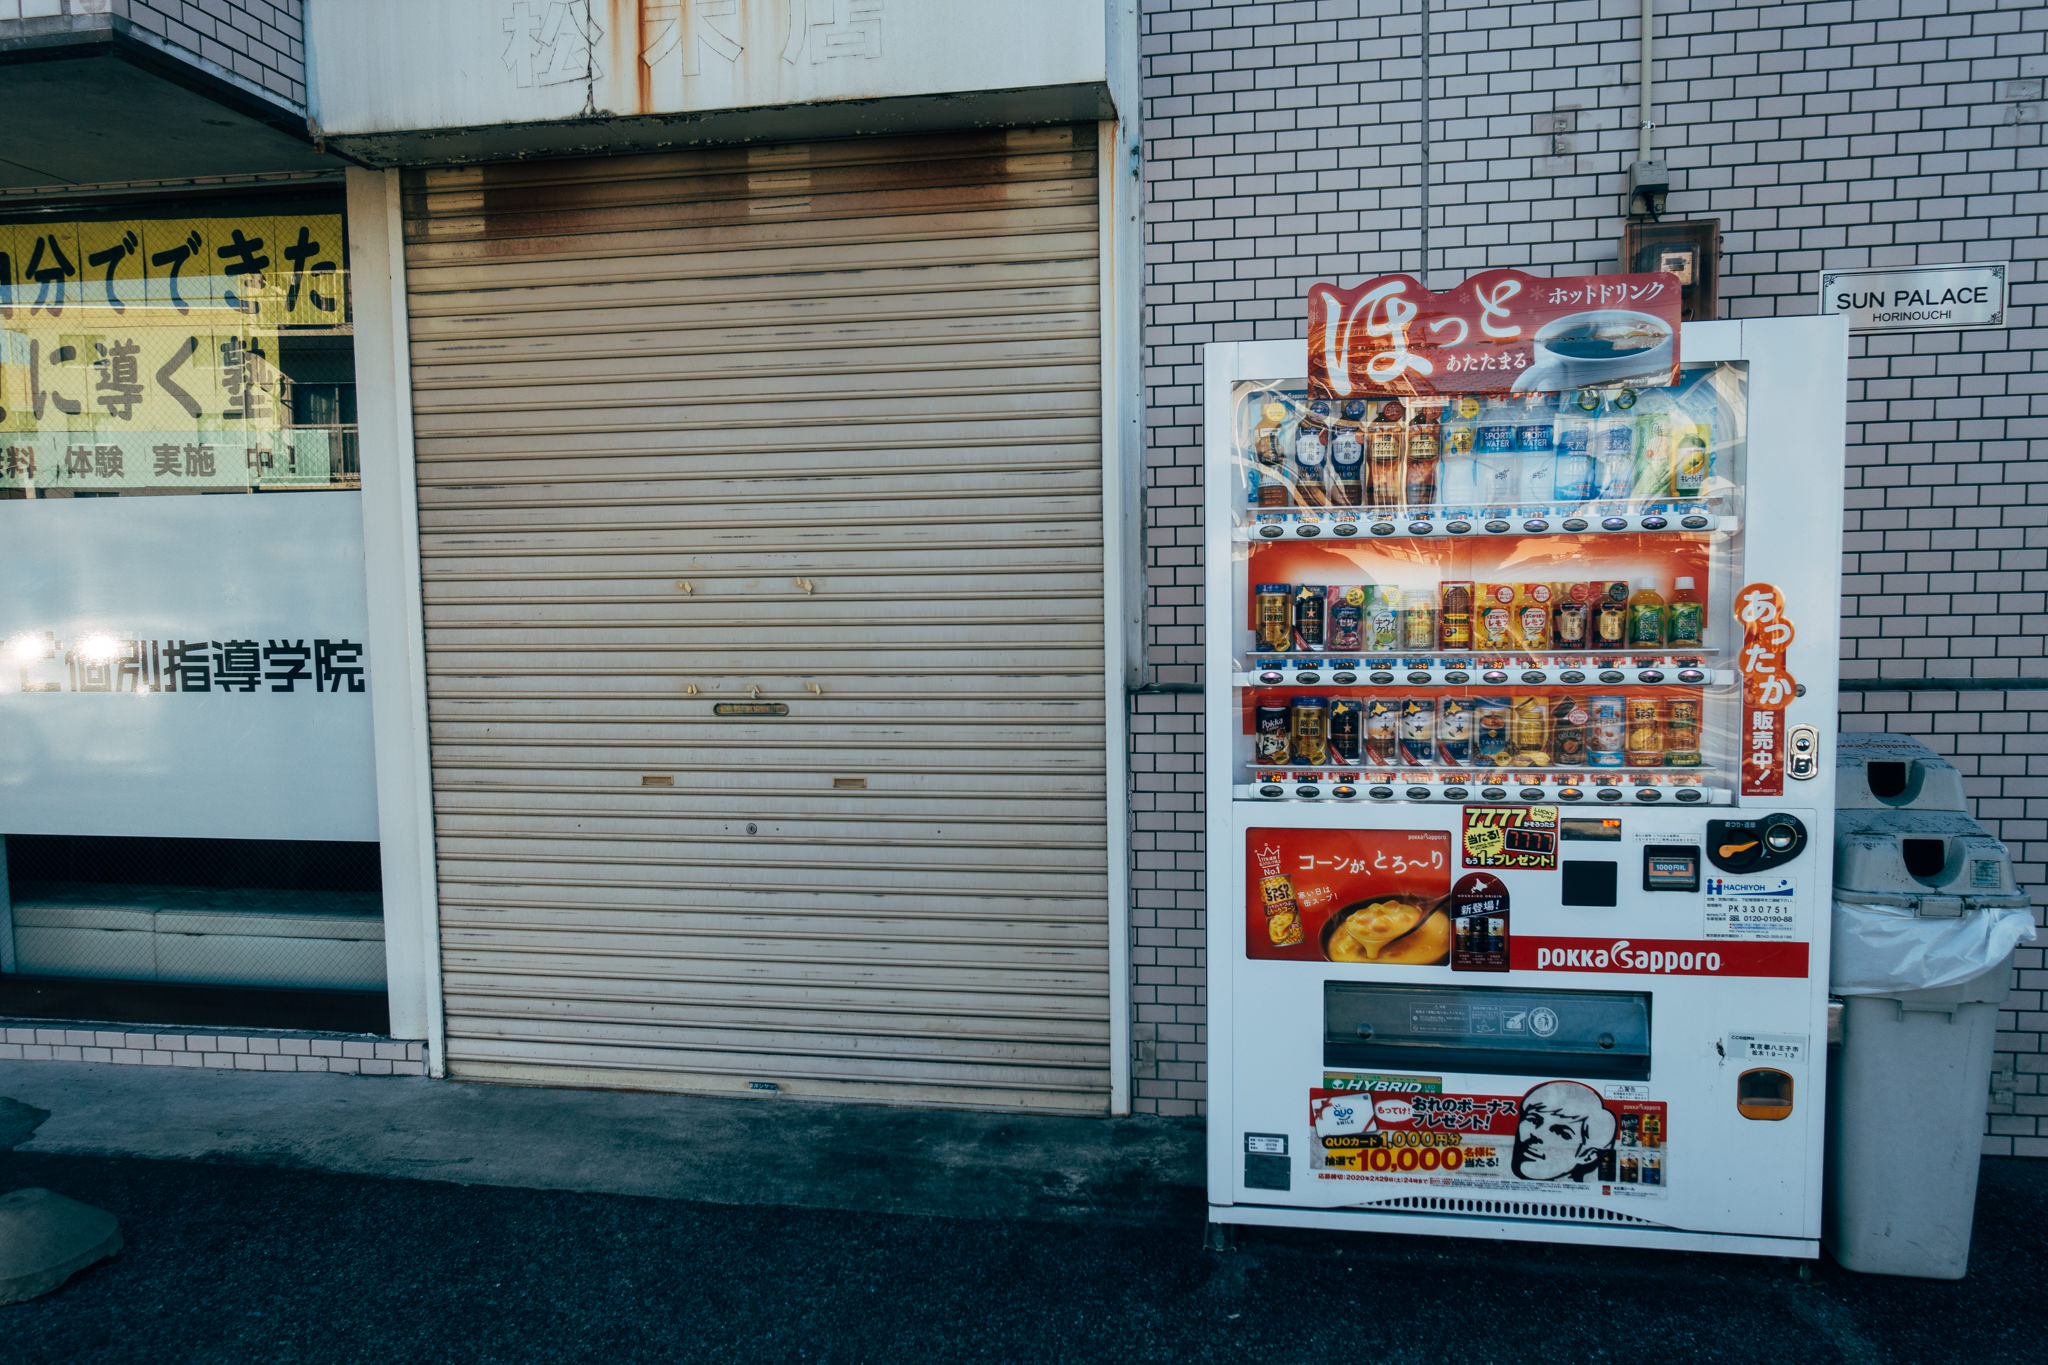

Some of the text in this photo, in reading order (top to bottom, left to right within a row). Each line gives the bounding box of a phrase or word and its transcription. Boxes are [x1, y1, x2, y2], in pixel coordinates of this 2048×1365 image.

[0, 227, 338, 320] 分でできた
[1548, 281, 1666, 305] ホットドリンク
[1836, 286, 1989, 310] SUN PALACE
[1872, 310, 1952, 322] HORINOUCHI
[1318, 279, 1521, 396] ほっと
[1446, 353, 1527, 373] あたたまる
[0, 335, 276, 423] に導く塾
[65, 445, 125, 479] 体験
[153, 443, 217, 478] 実施
[1741, 590, 1792, 705] あったか
[1261, 717, 1284, 729] Pokka
[1752, 711, 1775, 786] 販売中!
[1465, 808, 1527, 828] 7777
[1467, 829, 1500, 846] 当たる!
[1510, 831, 1553, 851] 7777
[1465, 850, 1555, 867] もう1本プレゼント!
[1263, 866, 1281, 876] No.1
[1460, 899, 1500, 916] 新登場!
[1728, 905, 1739, 913] PK
[1743, 915, 1793, 923] 0120-0190-88
[1345, 1079, 1422, 1094] HYBRID
[1333, 1107, 1354, 1119] QUO
[1377, 1105, 1411, 1116] もってけ!
[1412, 1096, 1517, 1115] おれのボーナス
[1412, 1113, 1491, 1130] プレゼント!
[1325, 1131, 1463, 1149] QUOカード 1,000円分
[1357, 1147, 1463, 1173] 10,000
[1463, 1147, 1497, 1158] 名様に
[1464, 1157, 1500, 1168] 当たる!
